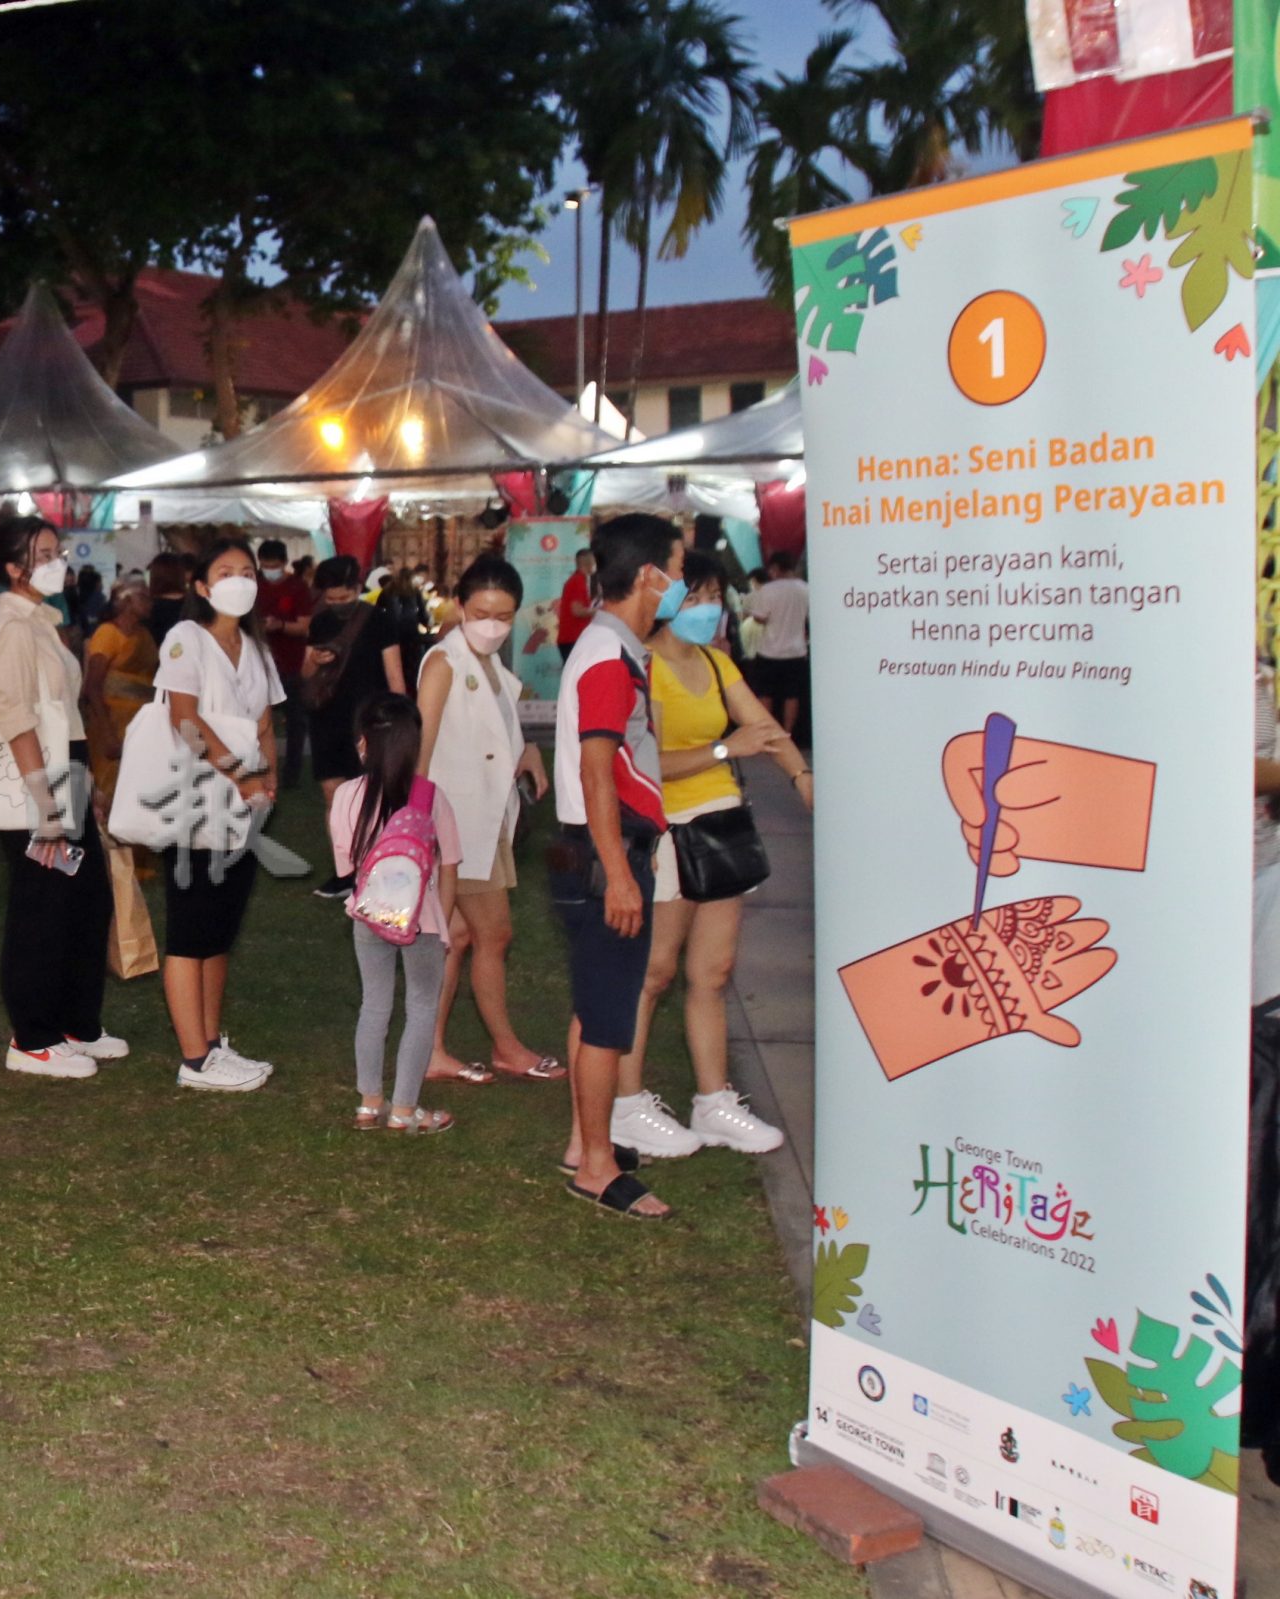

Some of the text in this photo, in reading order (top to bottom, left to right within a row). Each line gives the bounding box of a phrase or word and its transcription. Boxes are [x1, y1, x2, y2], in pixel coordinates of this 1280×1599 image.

[977, 316, 1006, 380] 1
[857, 431, 1156, 483] Henna: Seni Badan
[821, 475, 1226, 529] Inai Menjelang Perayaan
[876, 543, 1125, 579] Sertai perayaan kami,
[842, 582, 1181, 614] dapatkan seni lukisan tangan
[910, 618, 1095, 647] Henna percuma
[878, 658, 1132, 687] Persatuan Hindu Pulau Pinang
[954, 1136, 1043, 1174] George Town
[970, 1219, 1096, 1274] Celebrations 2022
[836, 1418, 873, 1445] GEORGE
[876, 1436, 905, 1459] TOWN
